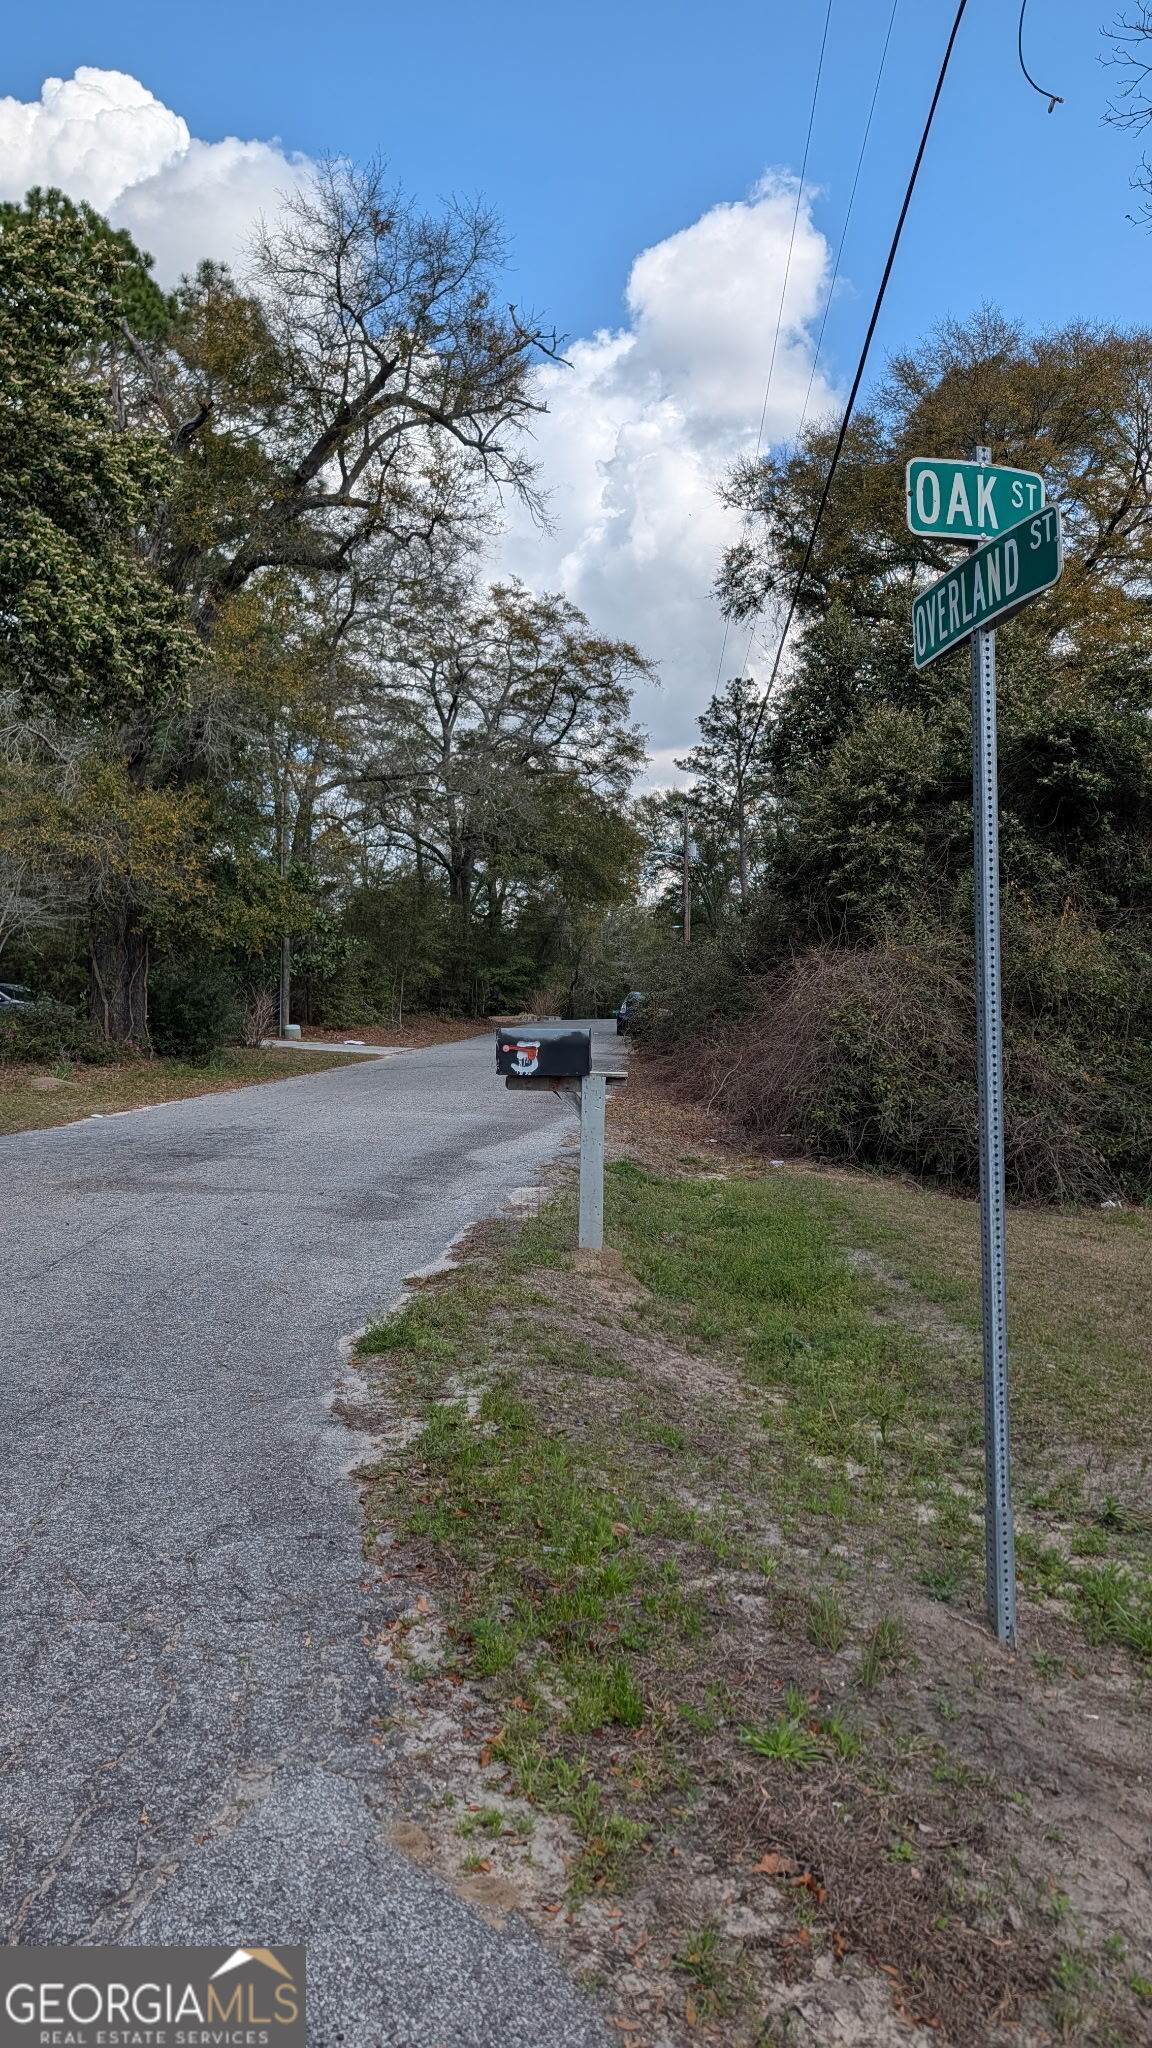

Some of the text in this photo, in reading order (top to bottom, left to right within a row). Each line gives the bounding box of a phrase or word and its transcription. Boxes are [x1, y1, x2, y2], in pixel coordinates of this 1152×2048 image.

[916, 469, 1037, 529] OAK ST
[916, 511, 1054, 656] OVERLAND ST
